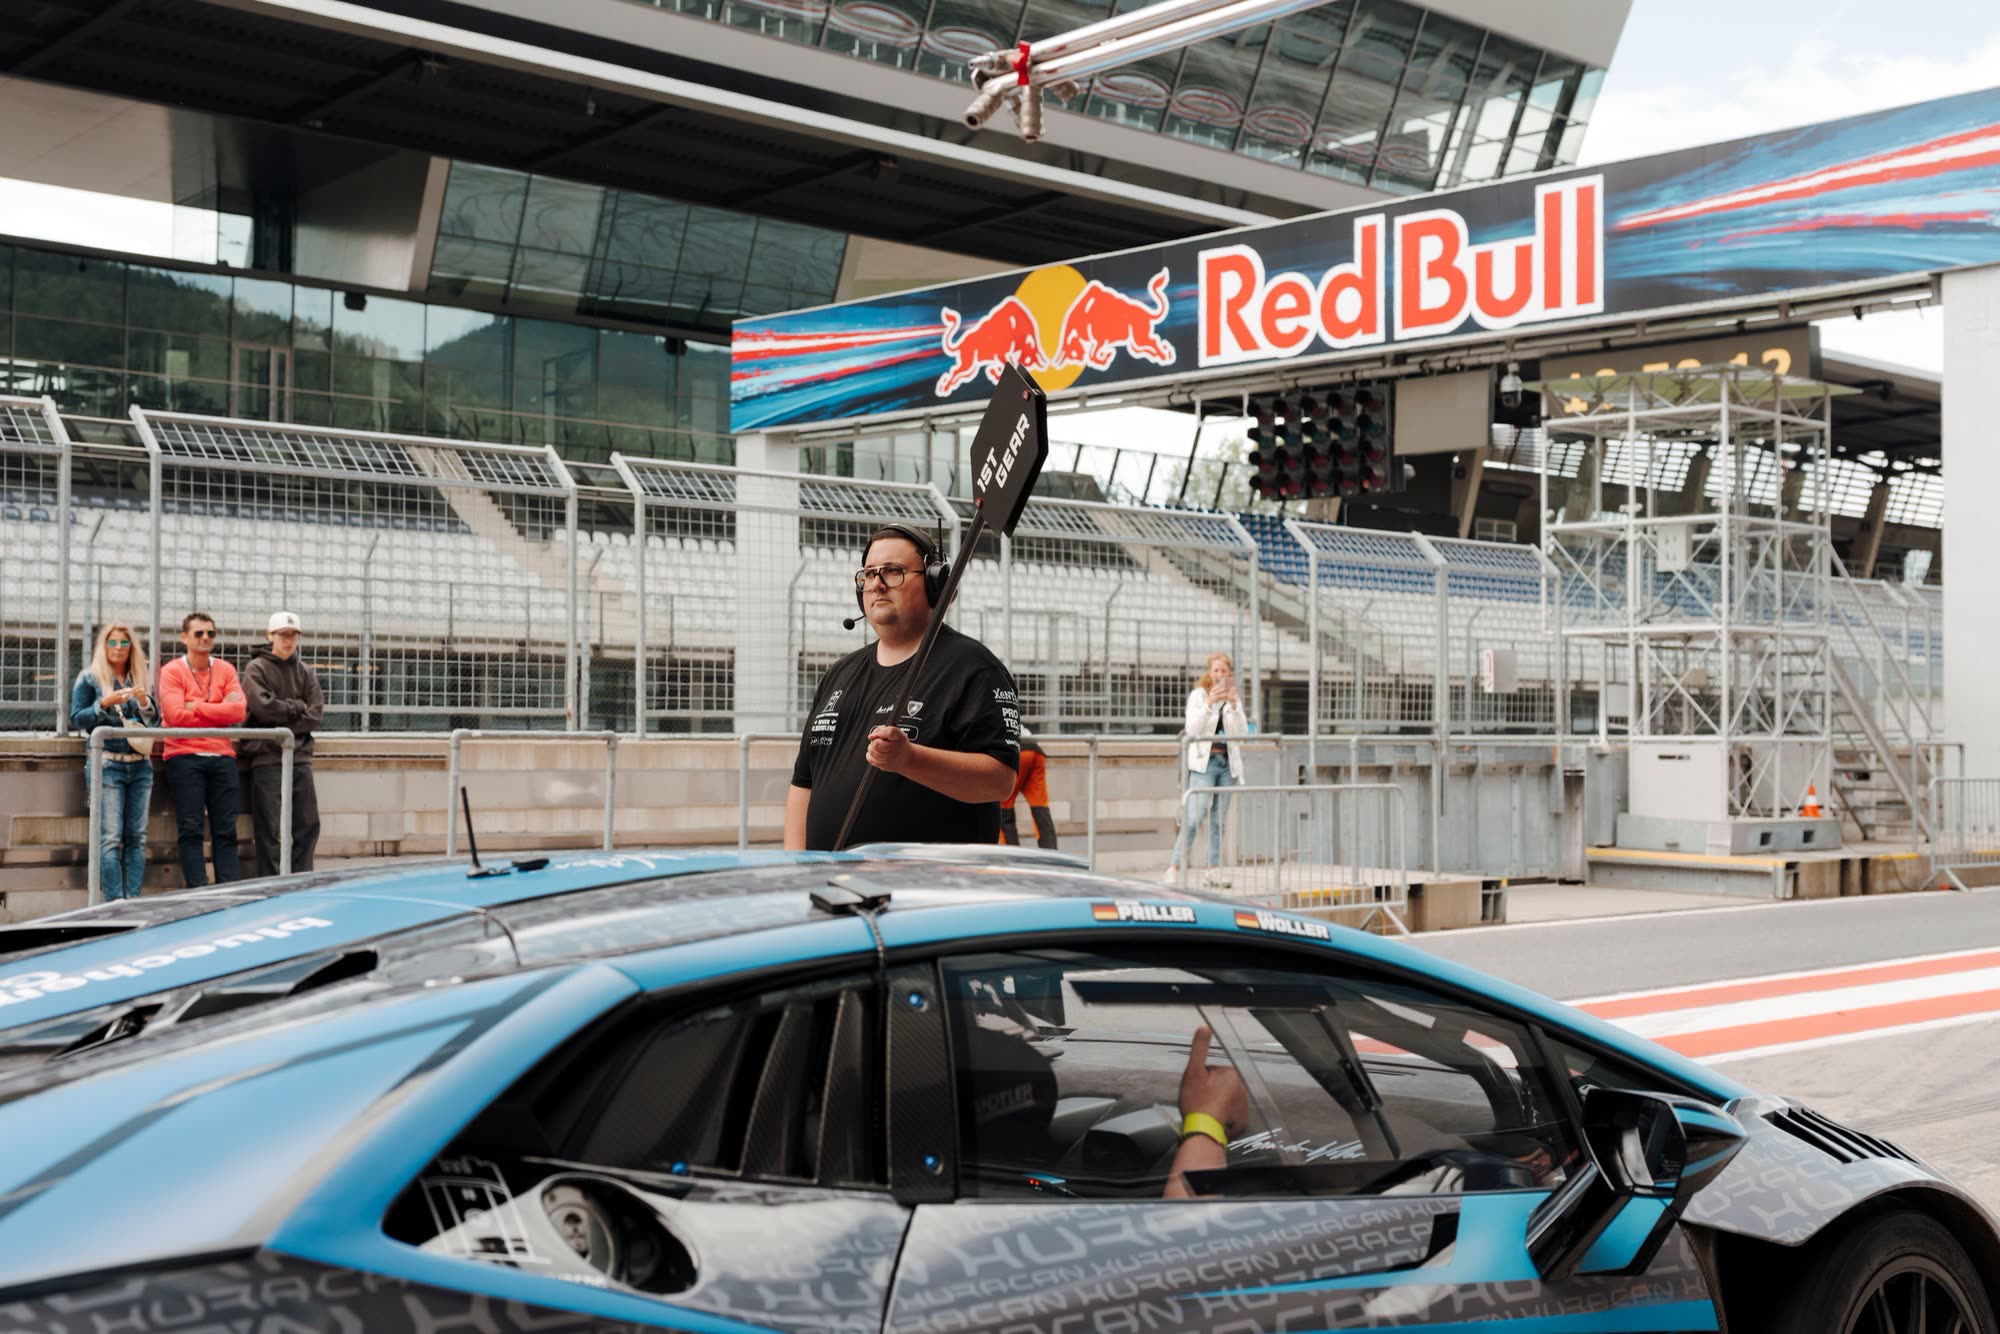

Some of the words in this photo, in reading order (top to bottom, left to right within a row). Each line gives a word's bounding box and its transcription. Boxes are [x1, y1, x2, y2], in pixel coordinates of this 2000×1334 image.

[1201, 217, 1382, 363] Red
[1396, 178, 1600, 336] Bull
[976, 447, 998, 493] 1ST
[995, 412, 1031, 489] GEAR
[1002, 707, 1018, 719] PRO
[1118, 904, 1196, 922] PRILLER
[1257, 913, 1330, 940] WOLLER
[897, 1264, 1083, 1312] HURACAN
[1090, 1233, 1254, 1277] HURACAN
[1257, 1205, 1401, 1247] HURACAN
[1074, 1250, 1281, 1305] HURACAN
